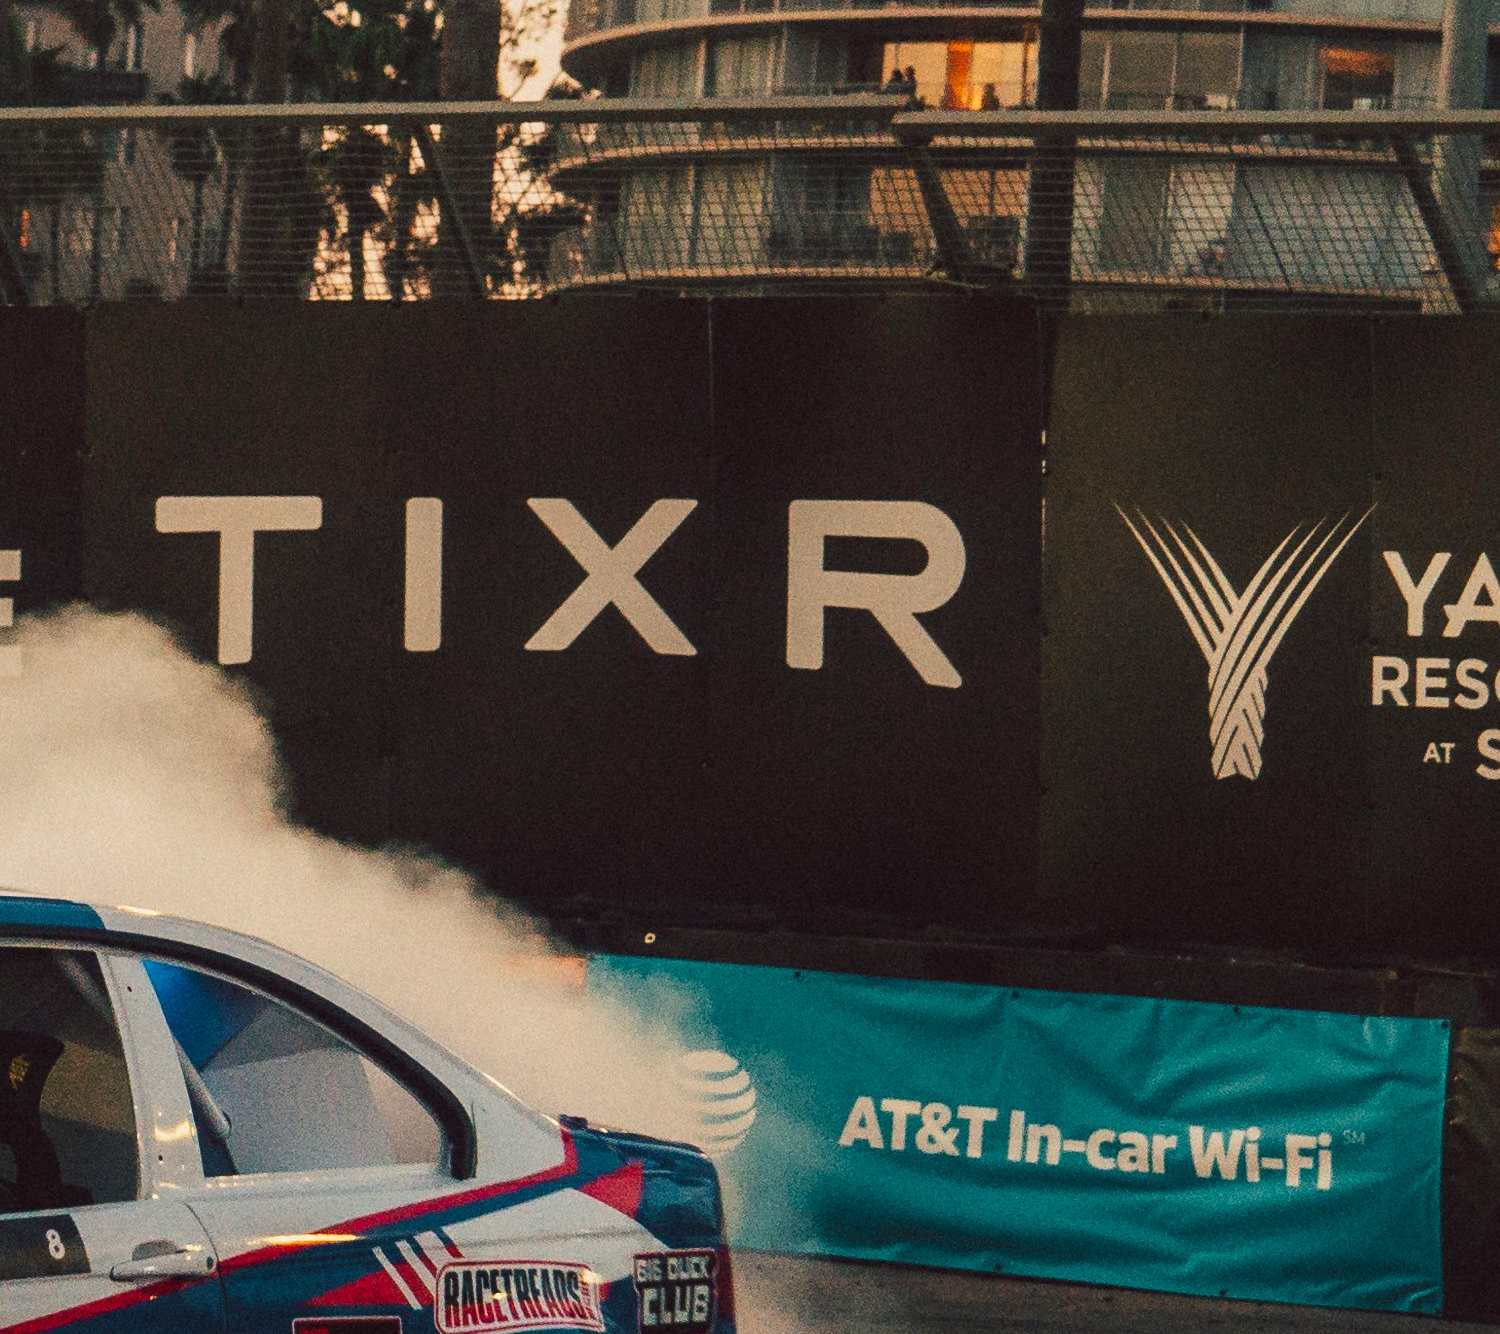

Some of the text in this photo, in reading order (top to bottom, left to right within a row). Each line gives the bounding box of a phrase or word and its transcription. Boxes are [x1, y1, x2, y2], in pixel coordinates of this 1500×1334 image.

[155, 495, 965, 689] TIXR
[1423, 743, 1455, 764] AT
[839, 1096, 998, 1158] AT&T
[1007, 1110, 1178, 1174] In-car
[1189, 1125, 1332, 1190] Wi-Fi
[45, 1228, 67, 1261] 8
[443, 1267, 588, 1329] RACETREADS
[641, 1284, 710, 1327] CLUB
